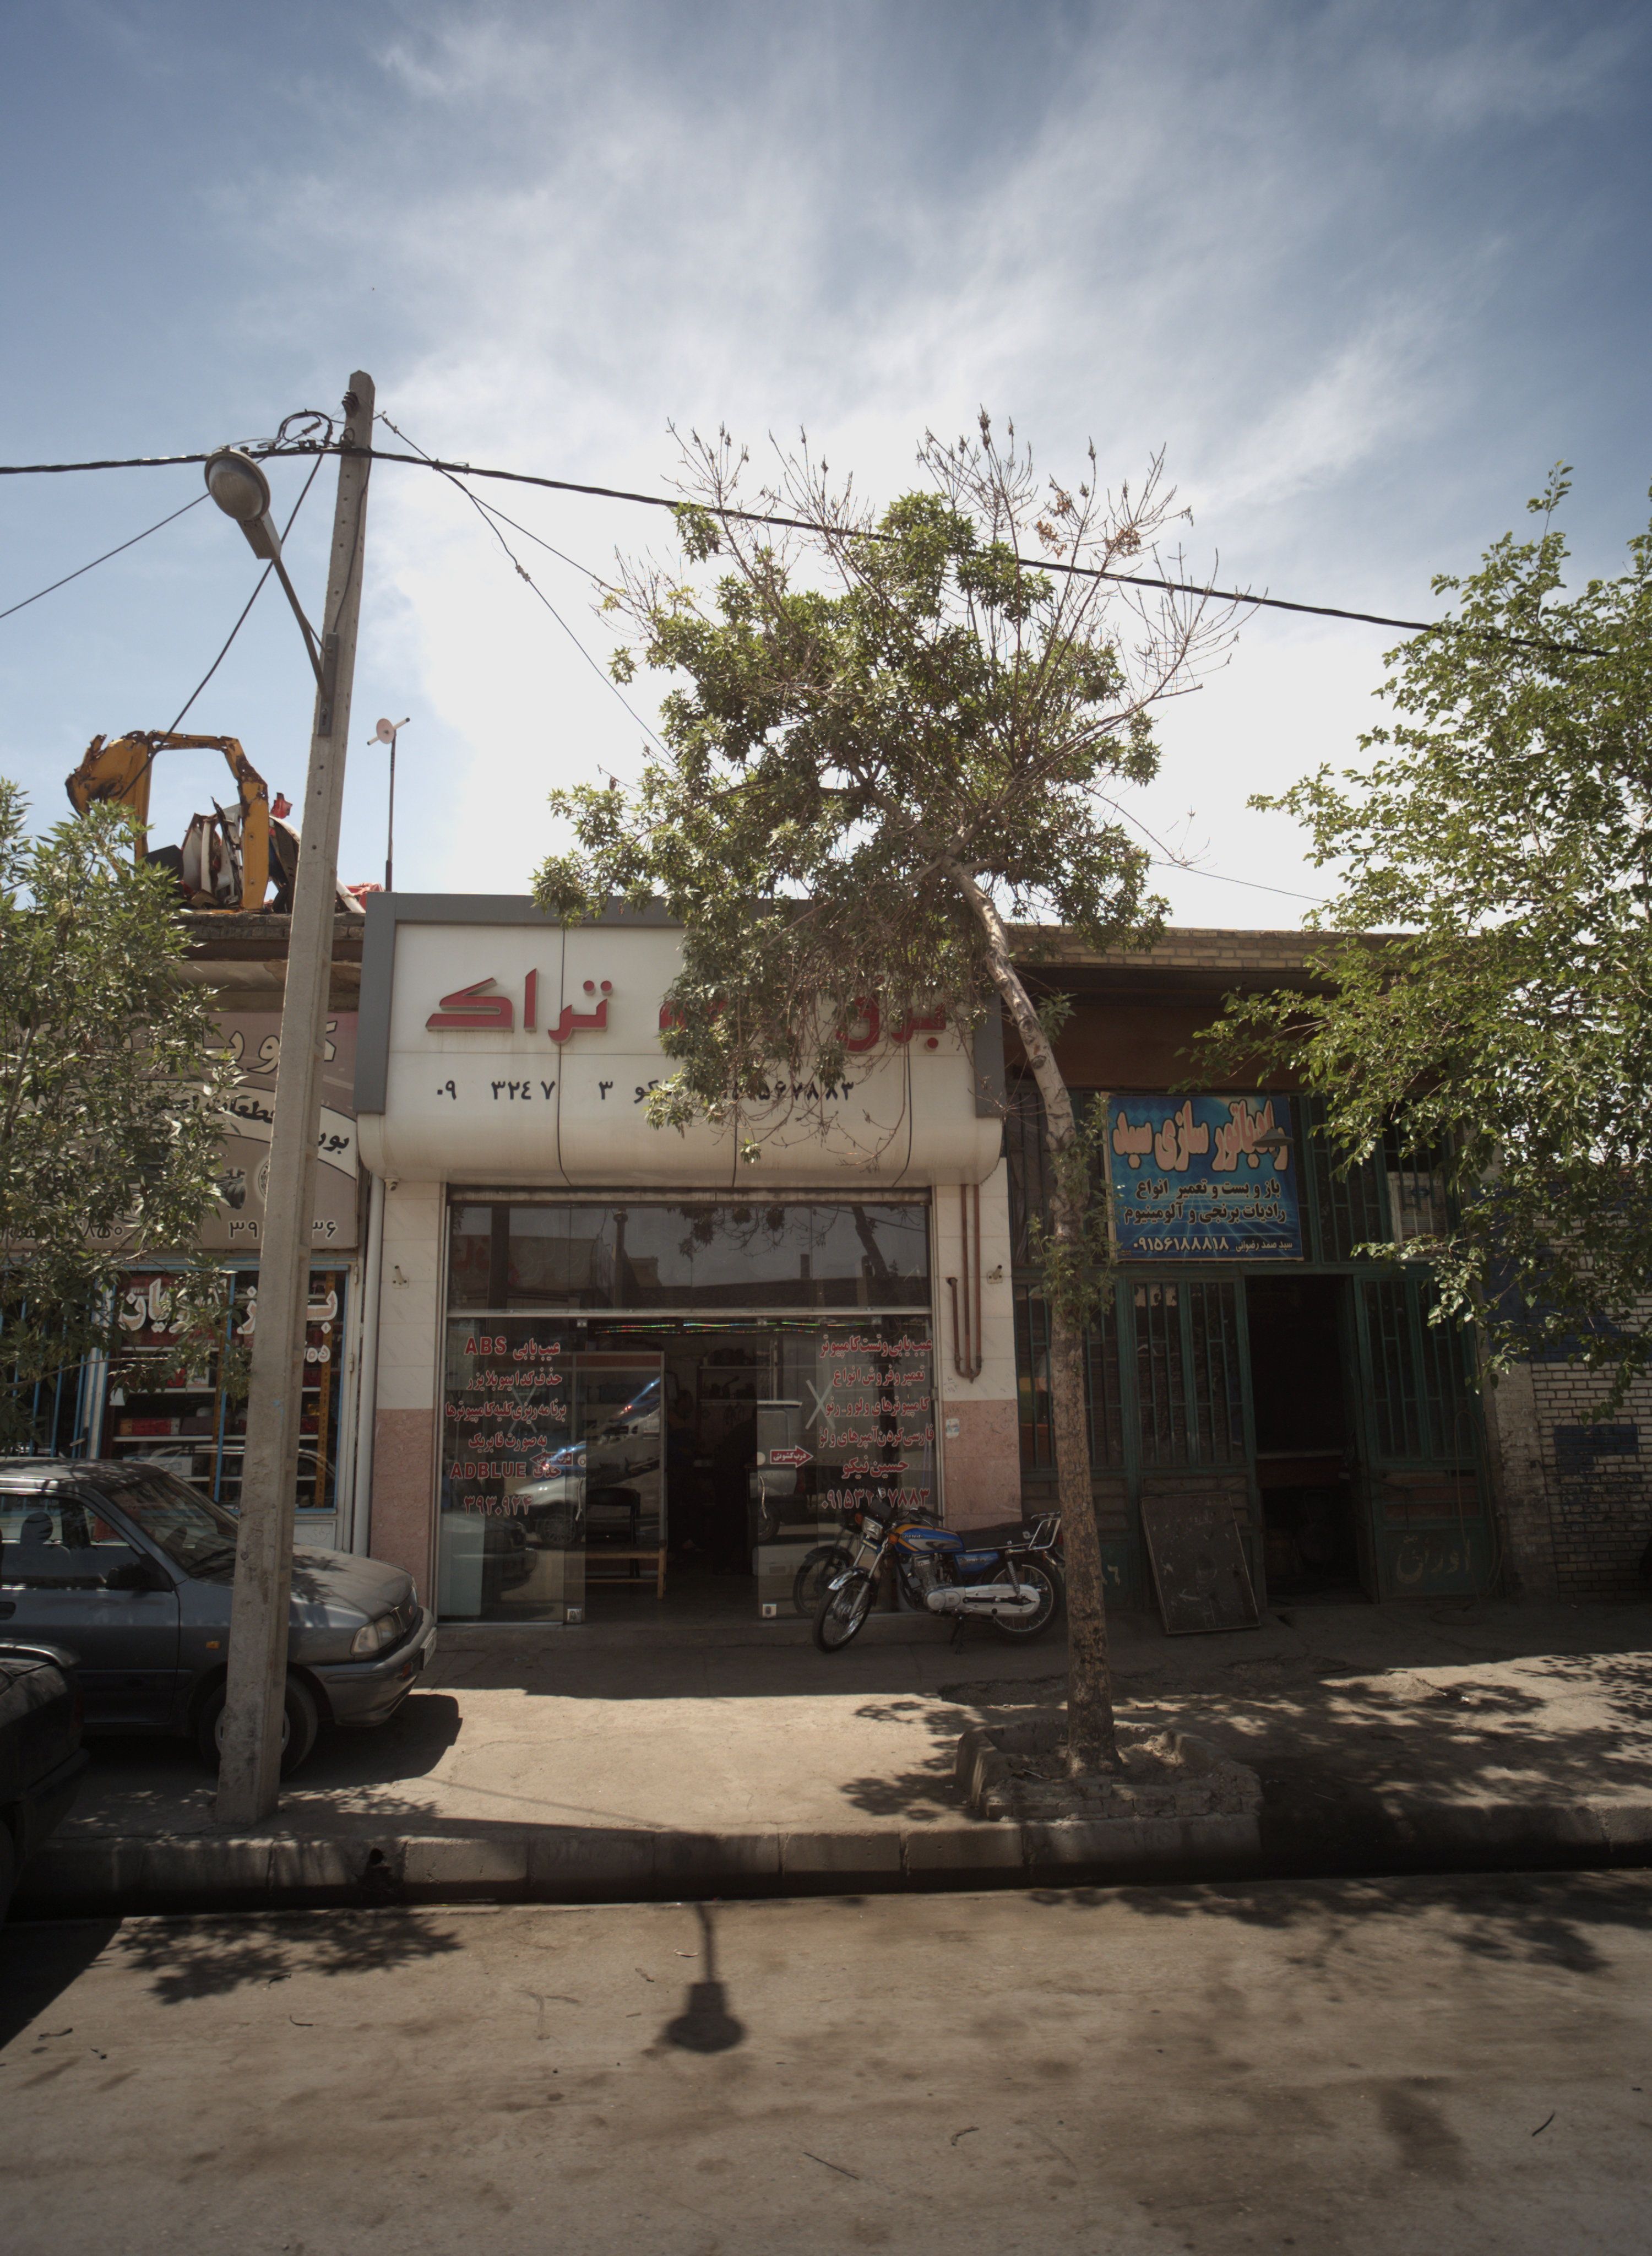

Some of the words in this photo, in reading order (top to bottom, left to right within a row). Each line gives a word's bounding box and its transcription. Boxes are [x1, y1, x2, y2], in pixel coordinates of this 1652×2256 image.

[425, 968, 612, 1043] تراک
[1112, 1111, 1153, 1169] سید
[1154, 1099, 1209, 1172] سازی
[1135, 1178, 1169, 1200] انواع
[1176, 1178, 1208, 1200] تعمیر
[1211, 1185, 1219, 1199] و
[1221, 1181, 1249, 1196] بست
[1253, 1185, 1261, 1198] و
[1264, 1178, 1281, 1200] باز
[1123, 1201, 1183, 1225] آلومینیوم
[1188, 1210, 1196, 1224] و
[1198, 1203, 1240, 1224] برنجی
[1242, 1202, 1286, 1224] رادیات
[1133, 1235, 1230, 1252] ۰۹۱۵۶۱۸۸۸۱۸
[464, 1336, 507, 1355] ABS
[819, 1334, 861, 1359] کامپیوتر
[858, 1333, 882, 1353] تست
[519, 1370, 535, 1386] کد
[534, 1366, 563, 1386] حذف
[833, 1365, 861, 1387] انواع
[862, 1364, 894, 1386] فروش
[894, 1372, 900, 1386] و
[900, 1365, 926, 1386] تعمیر
[493, 1401, 514, 1422] کلیه
[824, 1396, 841, 1417] رنو
[468, 1431, 504, 1454] فابریک
[504, 1433, 537, 1452] صورت
[536, 1434, 547, 1454] به
[903, 1424, 935, 1446] فارسی
[793, 1452, 807, 1461] درب
[449, 1461, 527, 1479] ADBLUE
[841, 1455, 870, 1480] نیکو
[870, 1460, 910, 1479] حسین
[464, 1494, 534, 1516] ۳۹۳۰۹۲۴
